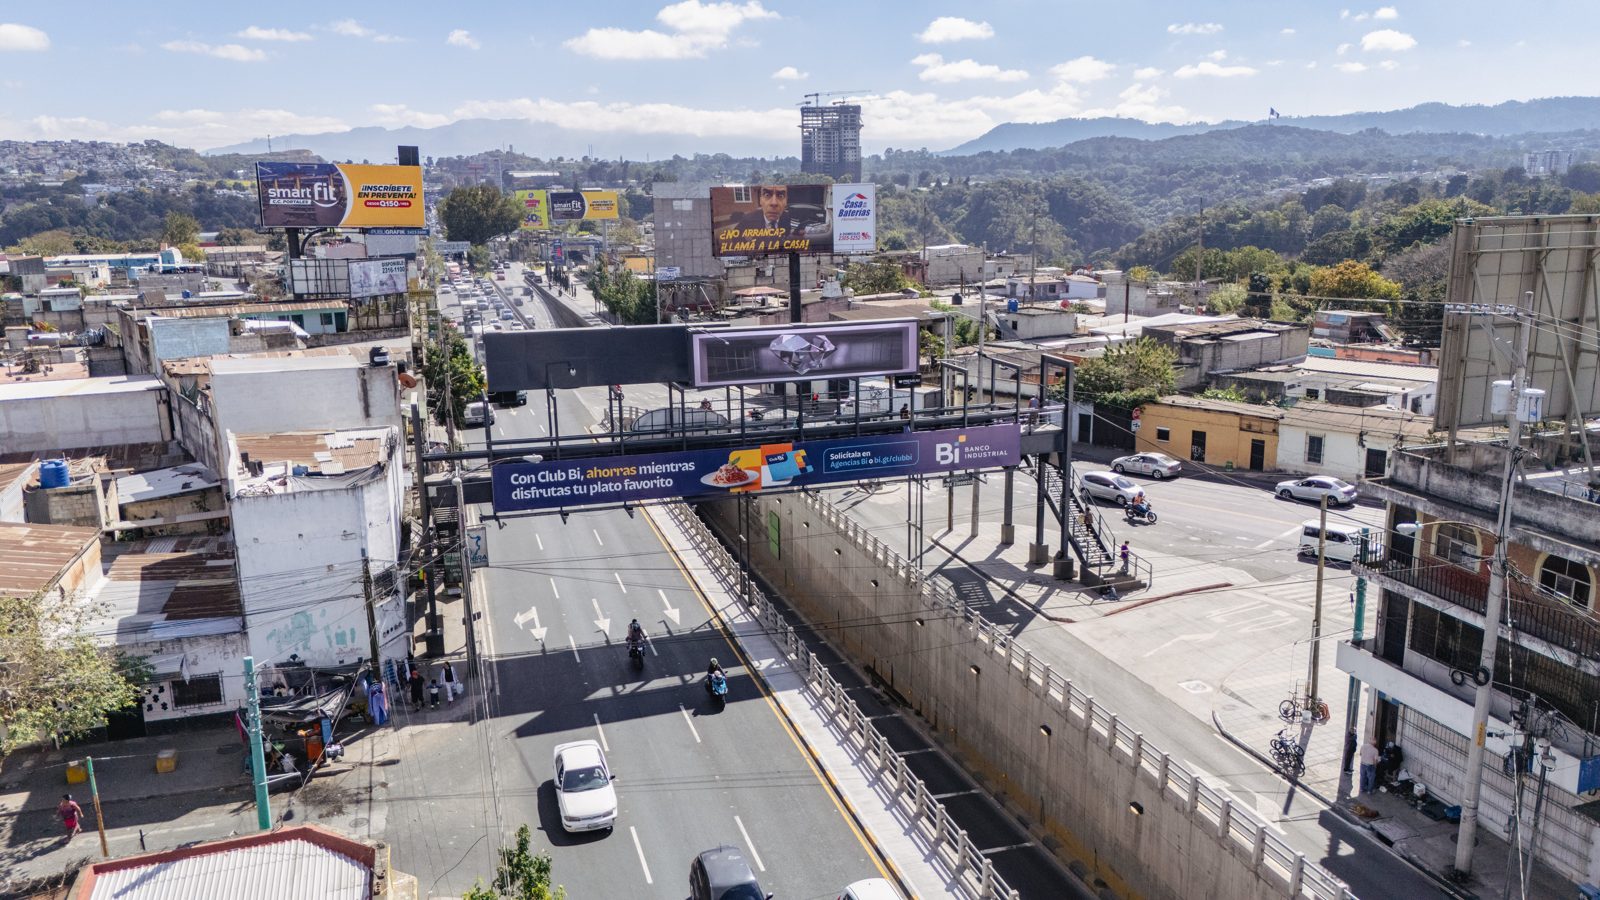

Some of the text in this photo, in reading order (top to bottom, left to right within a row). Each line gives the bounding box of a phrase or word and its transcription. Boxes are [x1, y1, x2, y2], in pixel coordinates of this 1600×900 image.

[268, 182, 337, 200] smart fit
[571, 200, 582, 208] fit
[844, 200, 863, 208] Casa
[720, 228, 786, 240] ¿NO ARRANCA?
[758, 242, 766, 250] A
[768, 241, 780, 250] LA
[783, 239, 810, 250] CASA!
[935, 435, 966, 465] Bi
[965, 444, 990, 452] BANCO
[830, 459, 860, 468] Agencias
[874, 453, 913, 464] bi.gt/clubbi
[965, 450, 1008, 459] INDUSTRIAL
[510, 461, 696, 485] Con Club Bi, ahorras mientras
[511, 477, 673, 500] disfrutas tu plato favorito
